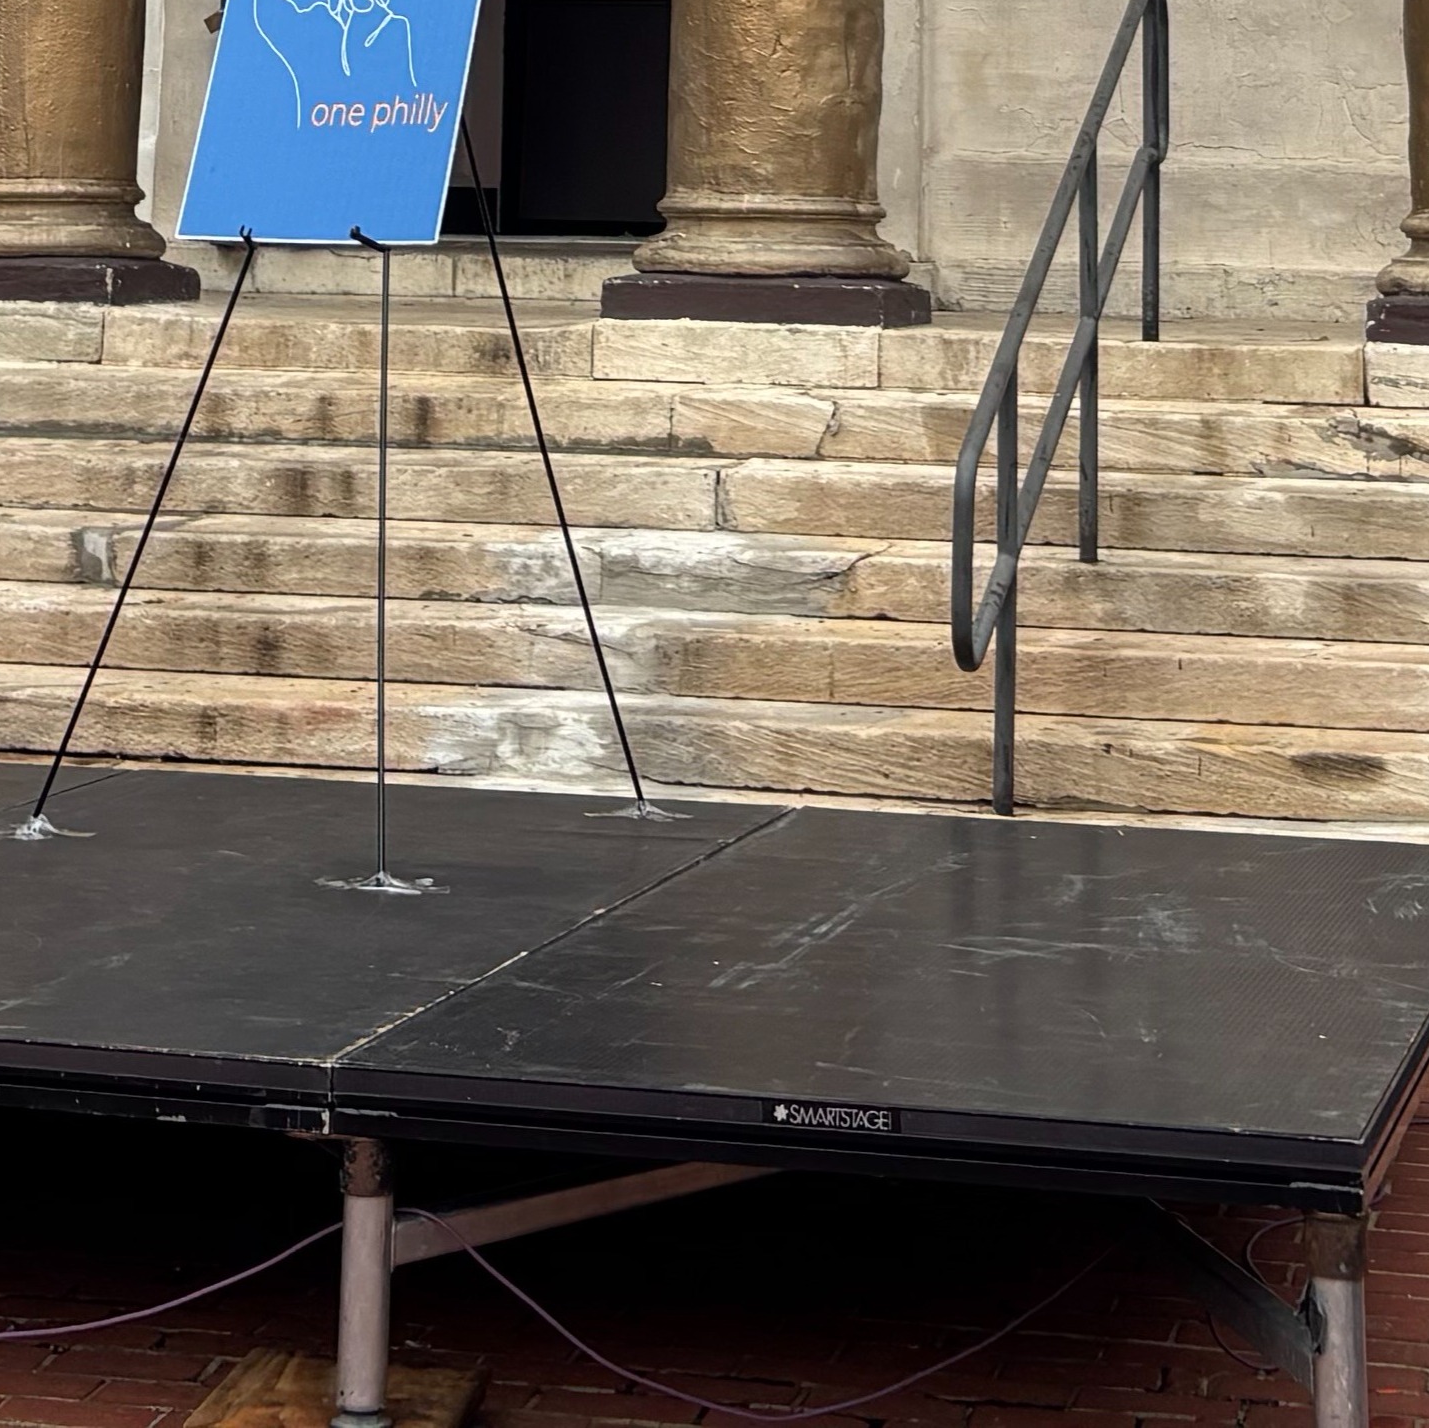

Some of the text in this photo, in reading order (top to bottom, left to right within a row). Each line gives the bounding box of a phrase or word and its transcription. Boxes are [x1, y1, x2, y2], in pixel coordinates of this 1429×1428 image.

[311, 93, 450, 134] one philly
[788, 1103, 892, 1131] SMARTSTAGE
